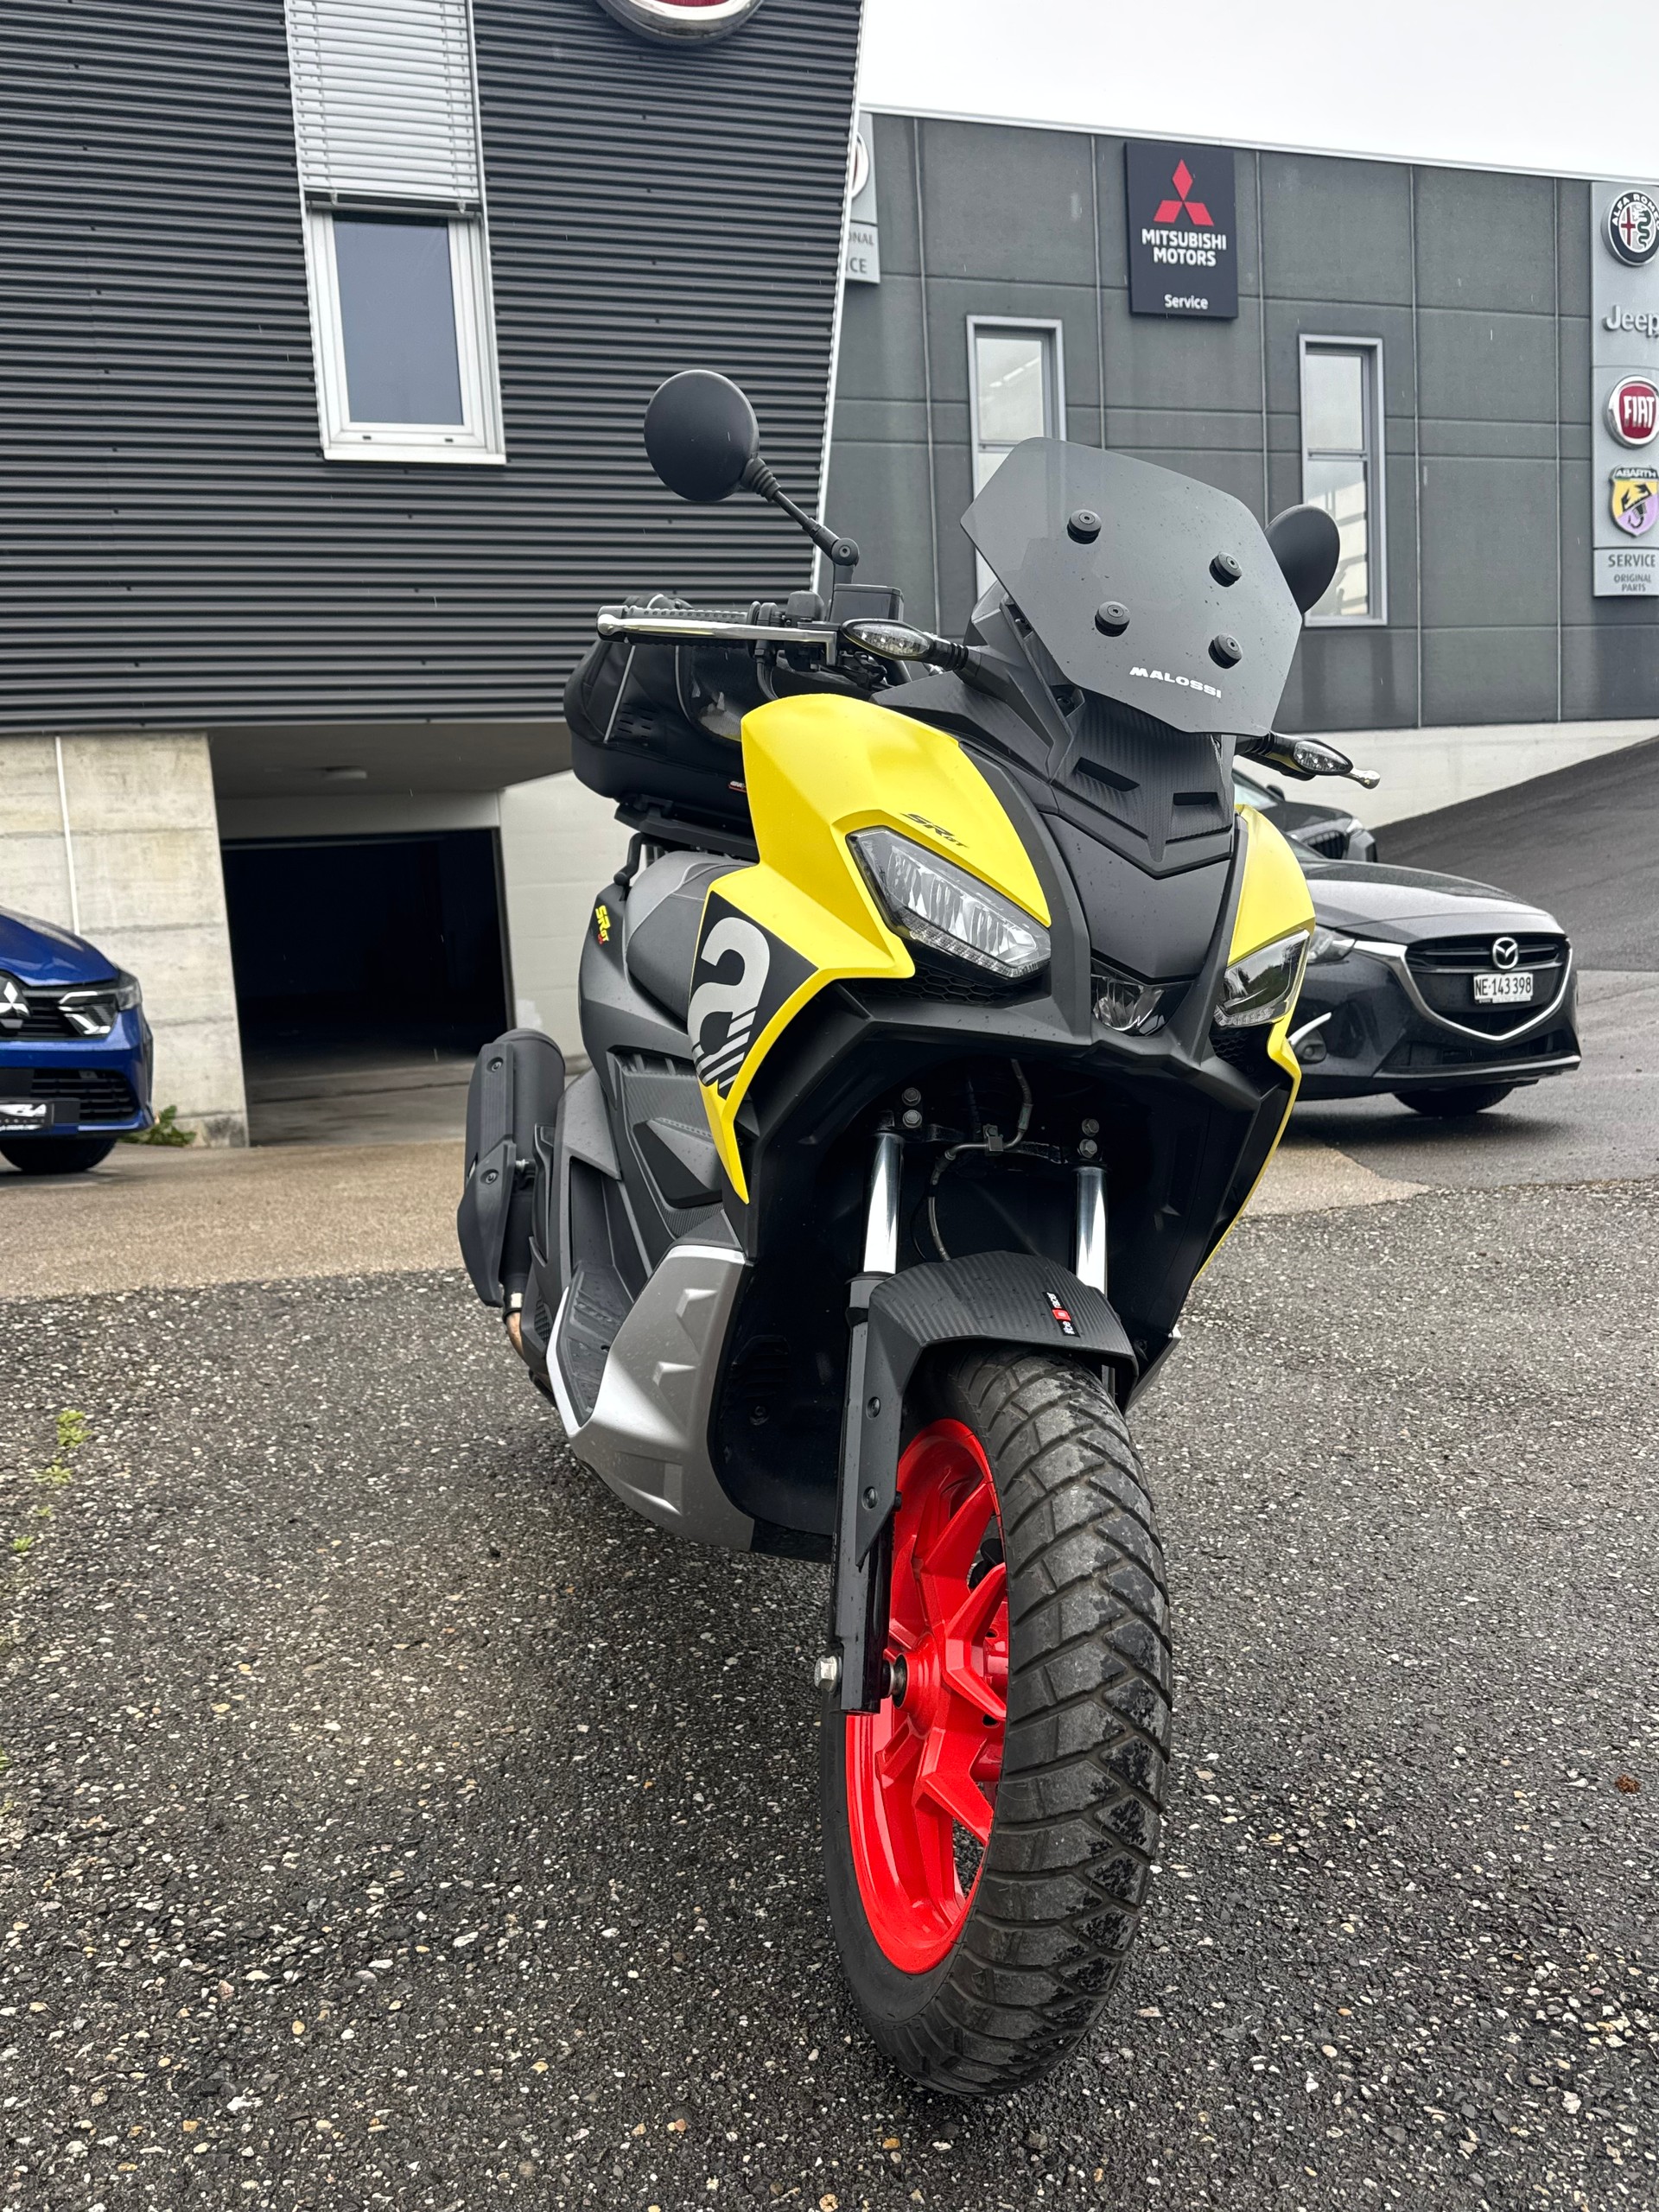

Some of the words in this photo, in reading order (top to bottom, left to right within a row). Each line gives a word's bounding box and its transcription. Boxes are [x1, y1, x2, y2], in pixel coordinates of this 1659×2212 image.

[1611, 196, 1630, 226] ALFA
[1141, 228, 1227, 251] MITSUBISHI
[1153, 247, 1217, 267] MOTORS
[1164, 294, 1209, 309] Service
[1602, 305, 1659, 338] Jeep
[1624, 396, 1655, 429] FIAT
[1616, 469, 1656, 478] ABARTH
[1608, 554, 1656, 568] SERVICE
[1613, 573, 1652, 584] ORIGINAL
[1621, 582, 1647, 592] PARTS
[1129, 666, 1222, 698] MALOSSI
